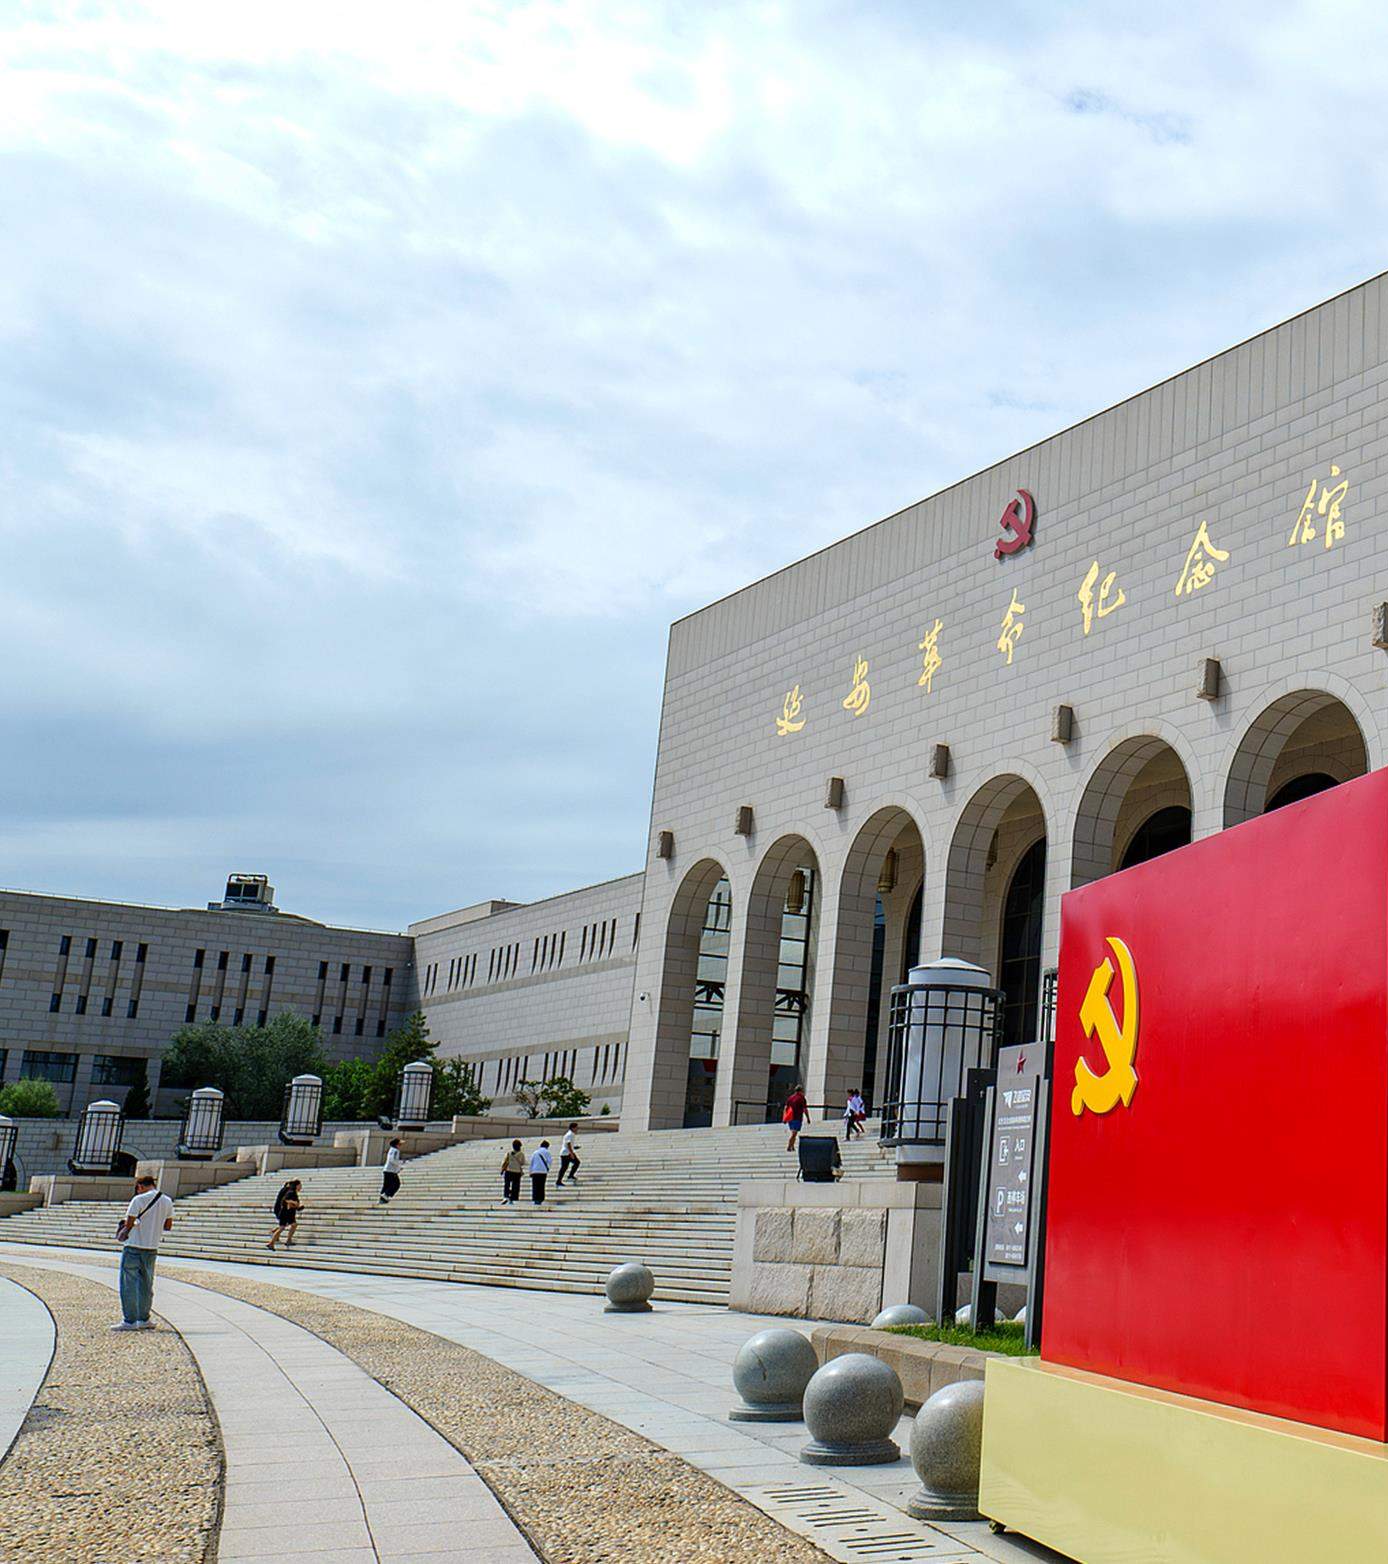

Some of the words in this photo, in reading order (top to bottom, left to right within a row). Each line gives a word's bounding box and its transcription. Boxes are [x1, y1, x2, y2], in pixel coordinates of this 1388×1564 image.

[775, 464, 1349, 736] 延安革命纪念馆
[996, 1190, 1005, 1213] P
